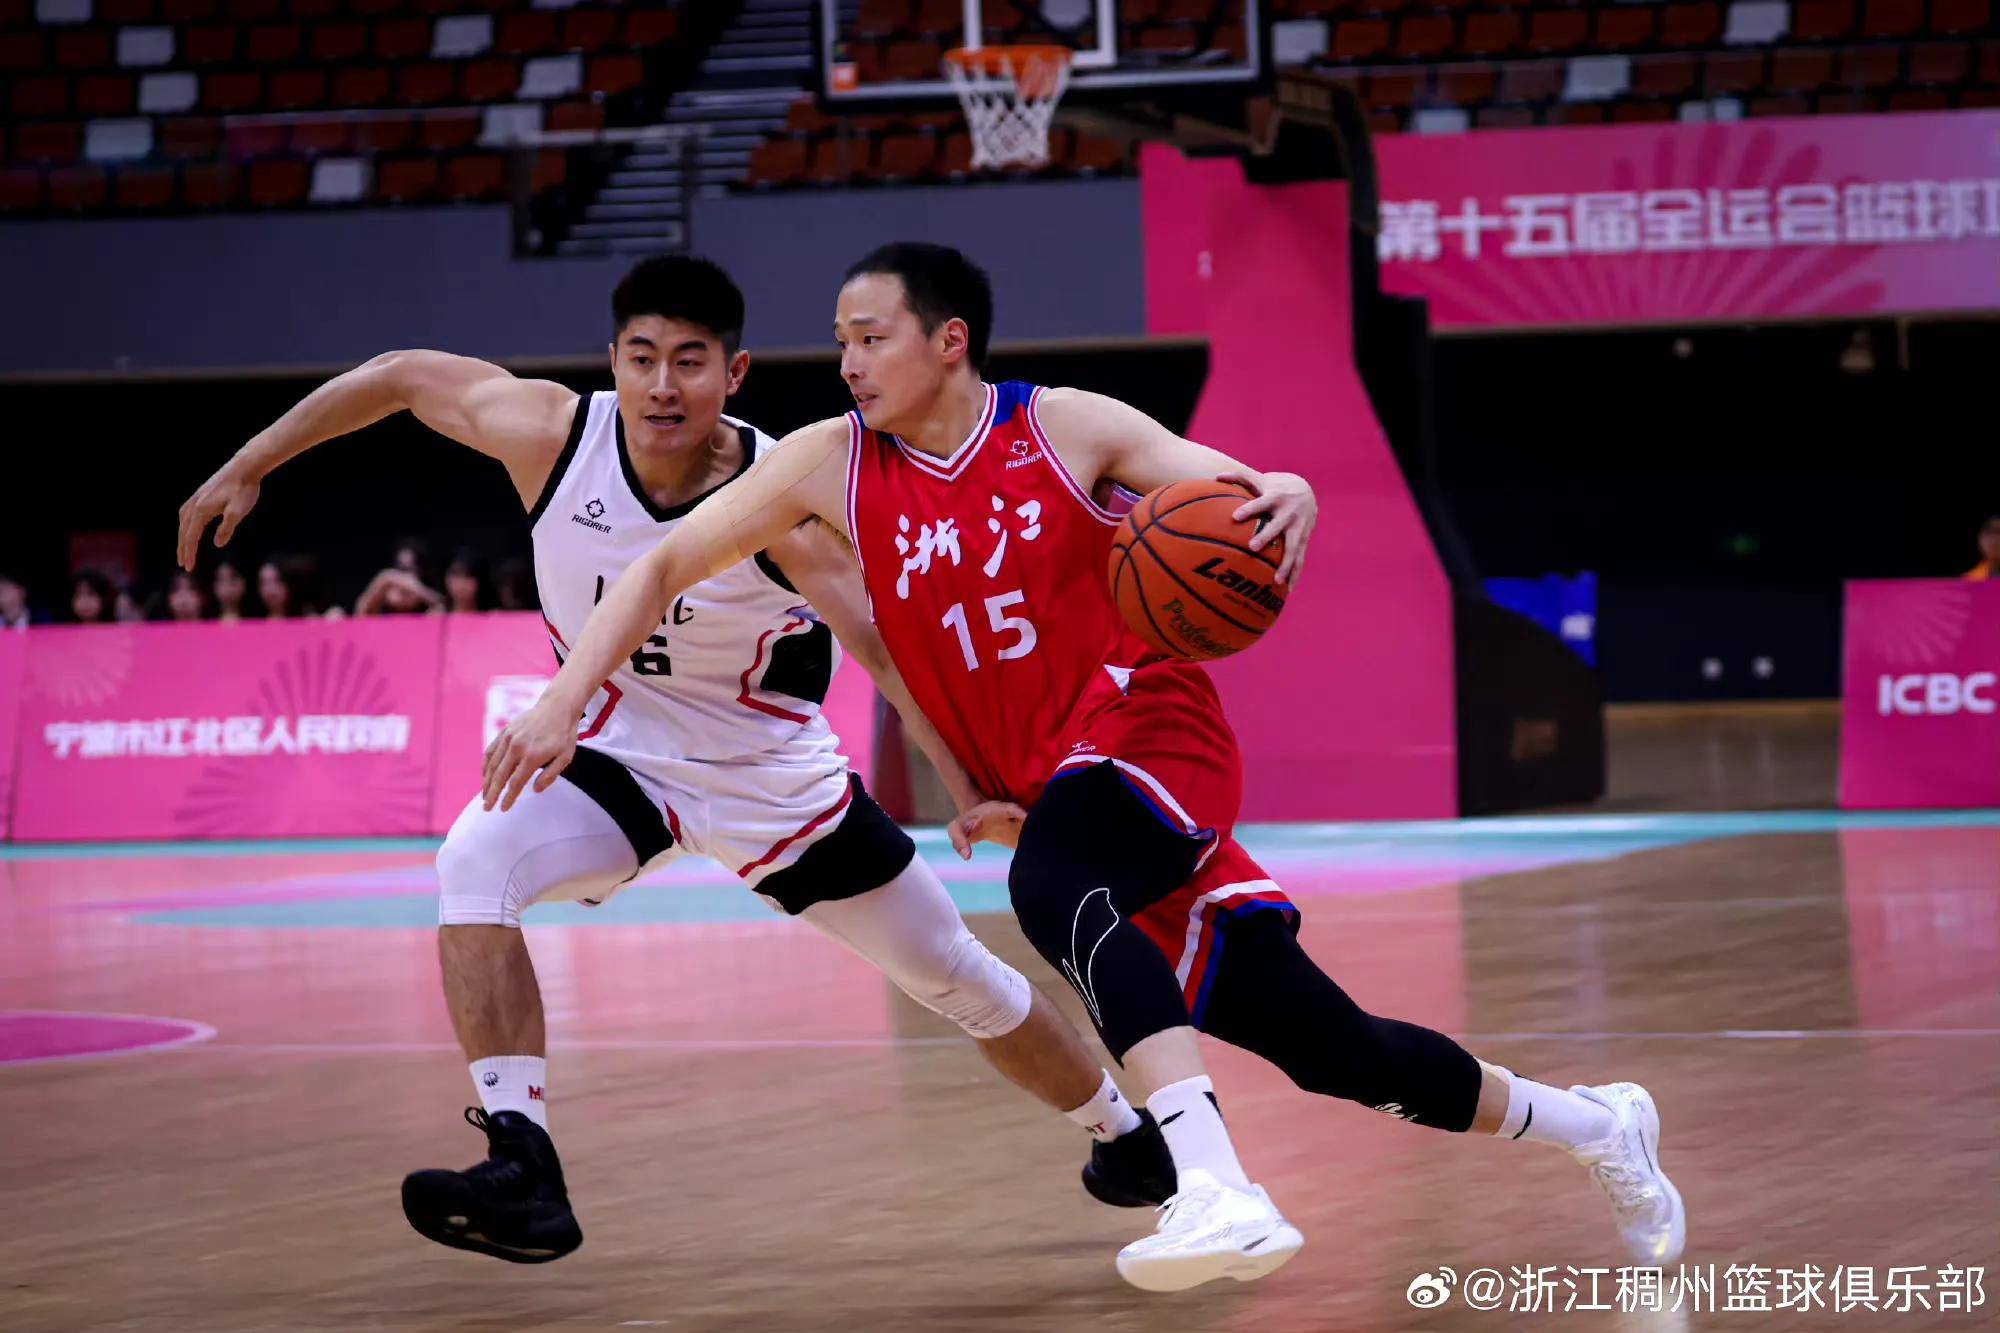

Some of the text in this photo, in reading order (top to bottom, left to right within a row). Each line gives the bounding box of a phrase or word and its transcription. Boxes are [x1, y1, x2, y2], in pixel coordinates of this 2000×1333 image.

[1005, 451, 1043, 472] RIGORER
[571, 513, 612, 535] RIGORER
[895, 495, 1041, 600] 浙江
[941, 588, 1038, 672] 15
[1877, 672, 1997, 716] ICBC
[44, 713, 411, 760] 宁波市江北区人民政府
